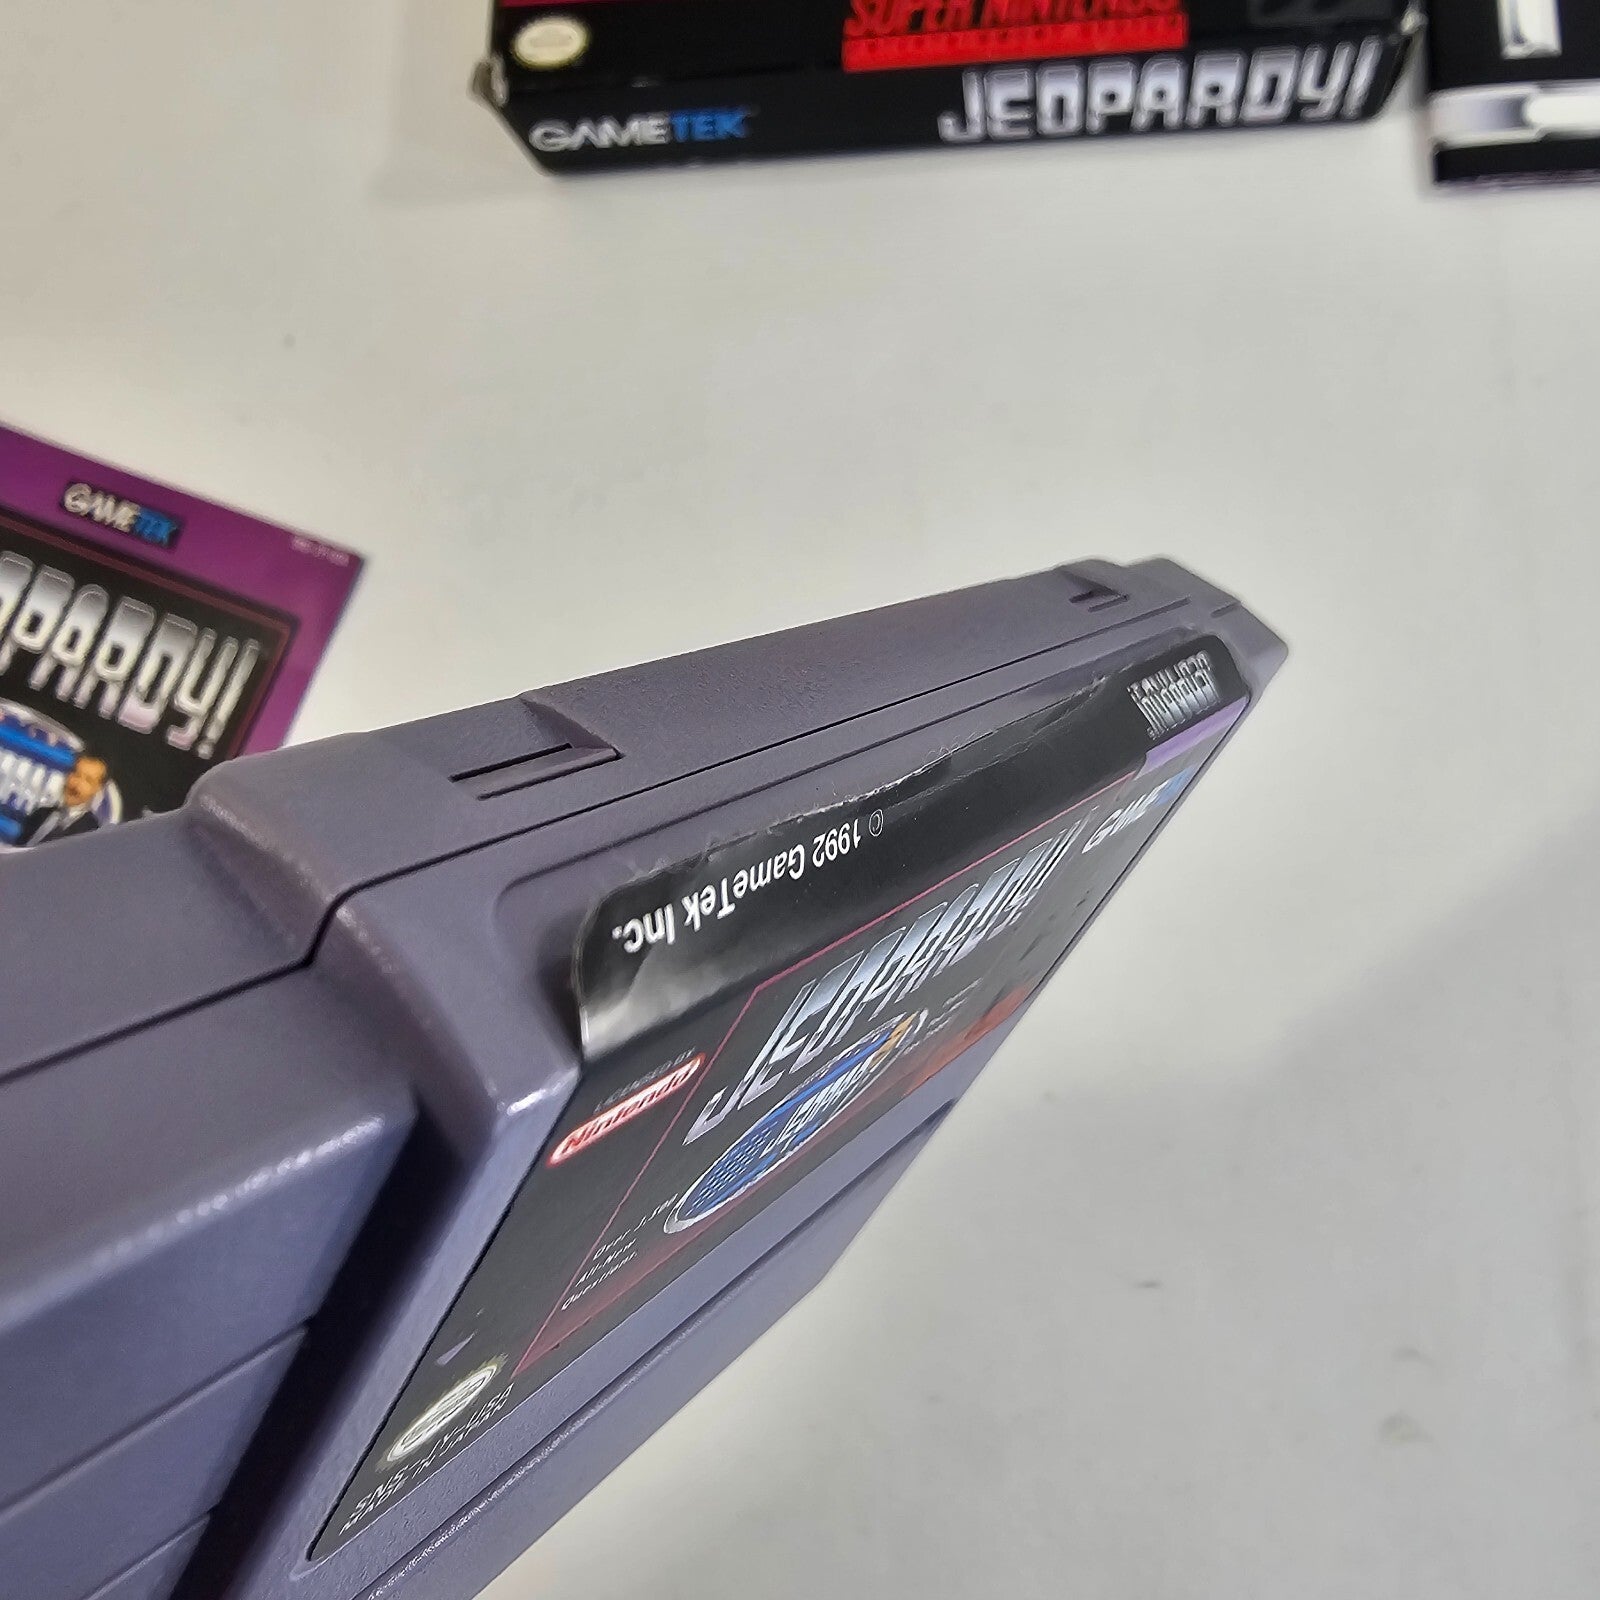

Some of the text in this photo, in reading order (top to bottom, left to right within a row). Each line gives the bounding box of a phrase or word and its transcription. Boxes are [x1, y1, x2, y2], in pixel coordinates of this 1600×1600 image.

[937, 35, 1382, 143] JEOPARDY!
[528, 107, 751, 152] GAMETEK
[812, 818, 862, 868] 1992
[681, 844, 806, 932] GameTek
[611, 903, 675, 953] Inc.
[560, 1062, 698, 1156] Nintendo
